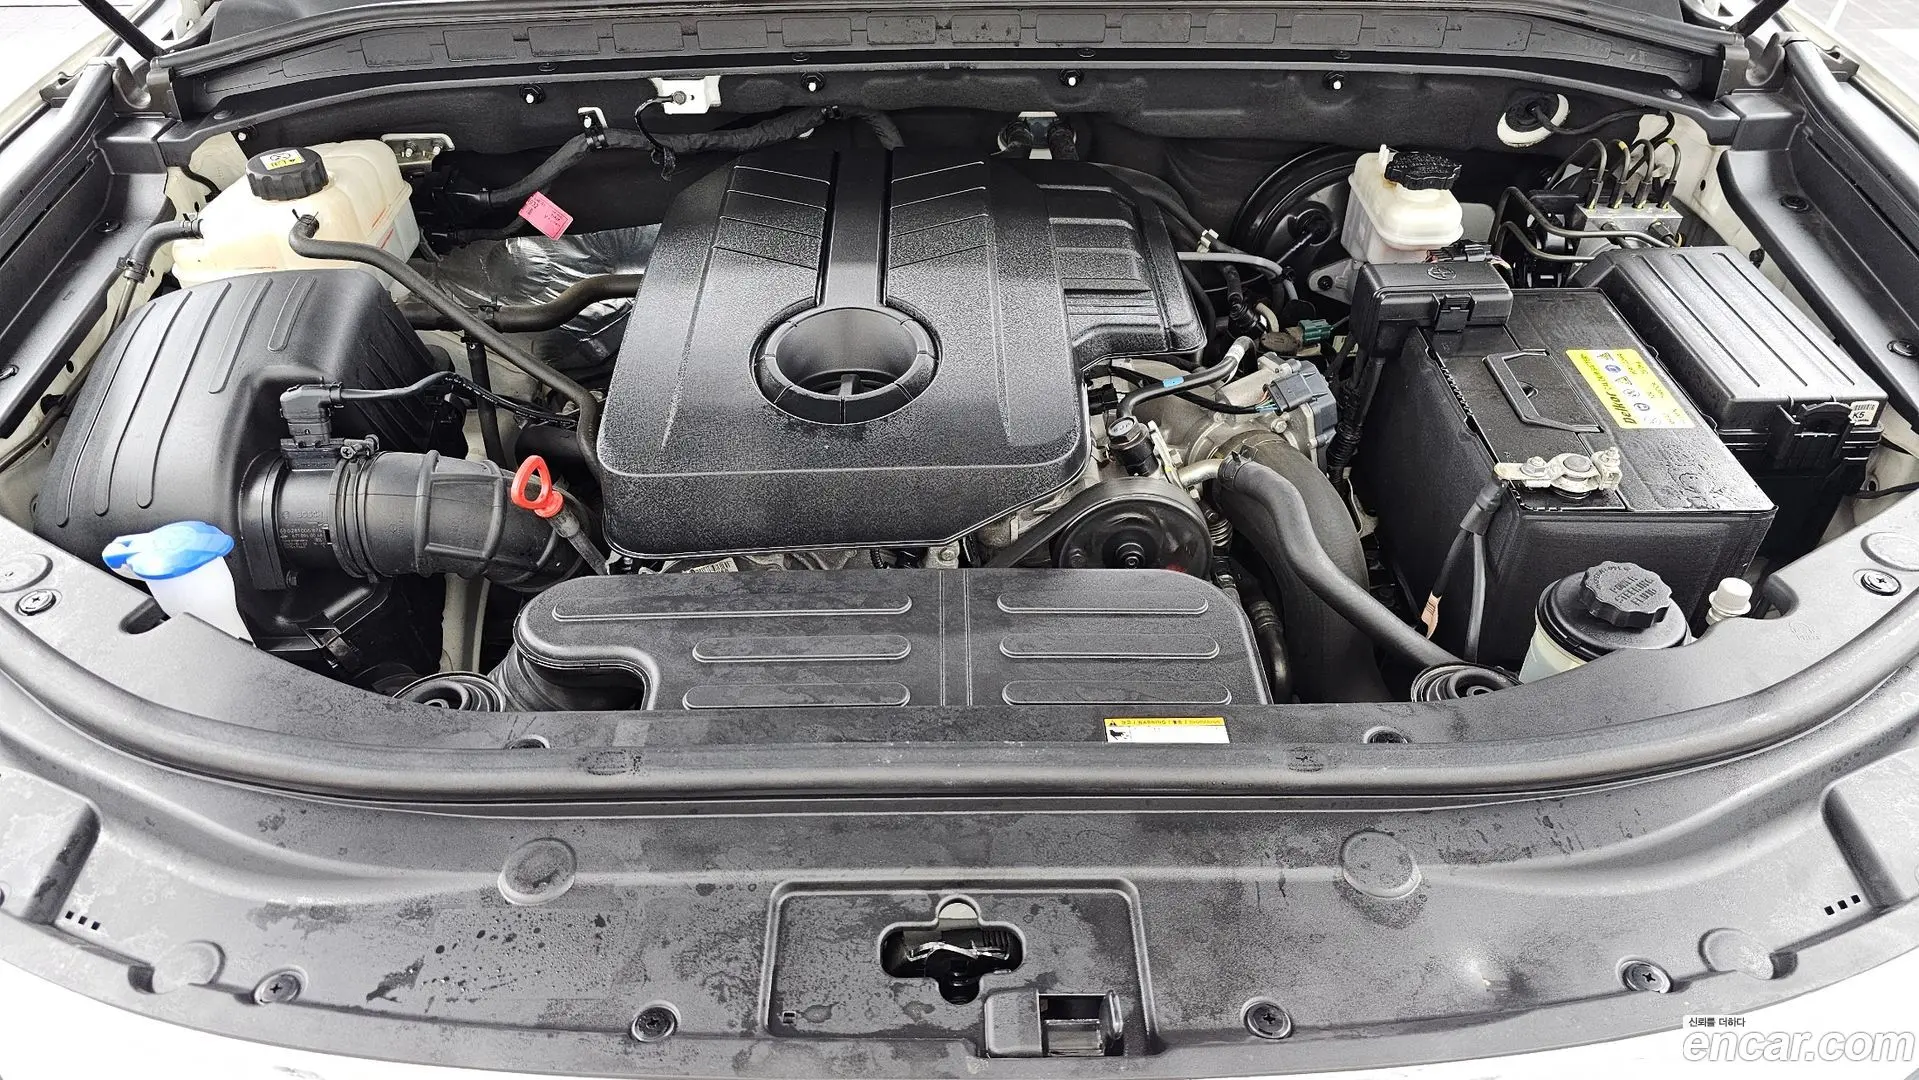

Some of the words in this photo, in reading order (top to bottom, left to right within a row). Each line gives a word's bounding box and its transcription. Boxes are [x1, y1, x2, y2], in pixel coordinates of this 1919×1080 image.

[1606, 391, 1637, 425] Delkor
[1852, 411, 1866, 419] K5
[1609, 576, 1638, 594] POWER
[1614, 577, 1654, 603] STEERING
[1630, 588, 1657, 606] FLUID
